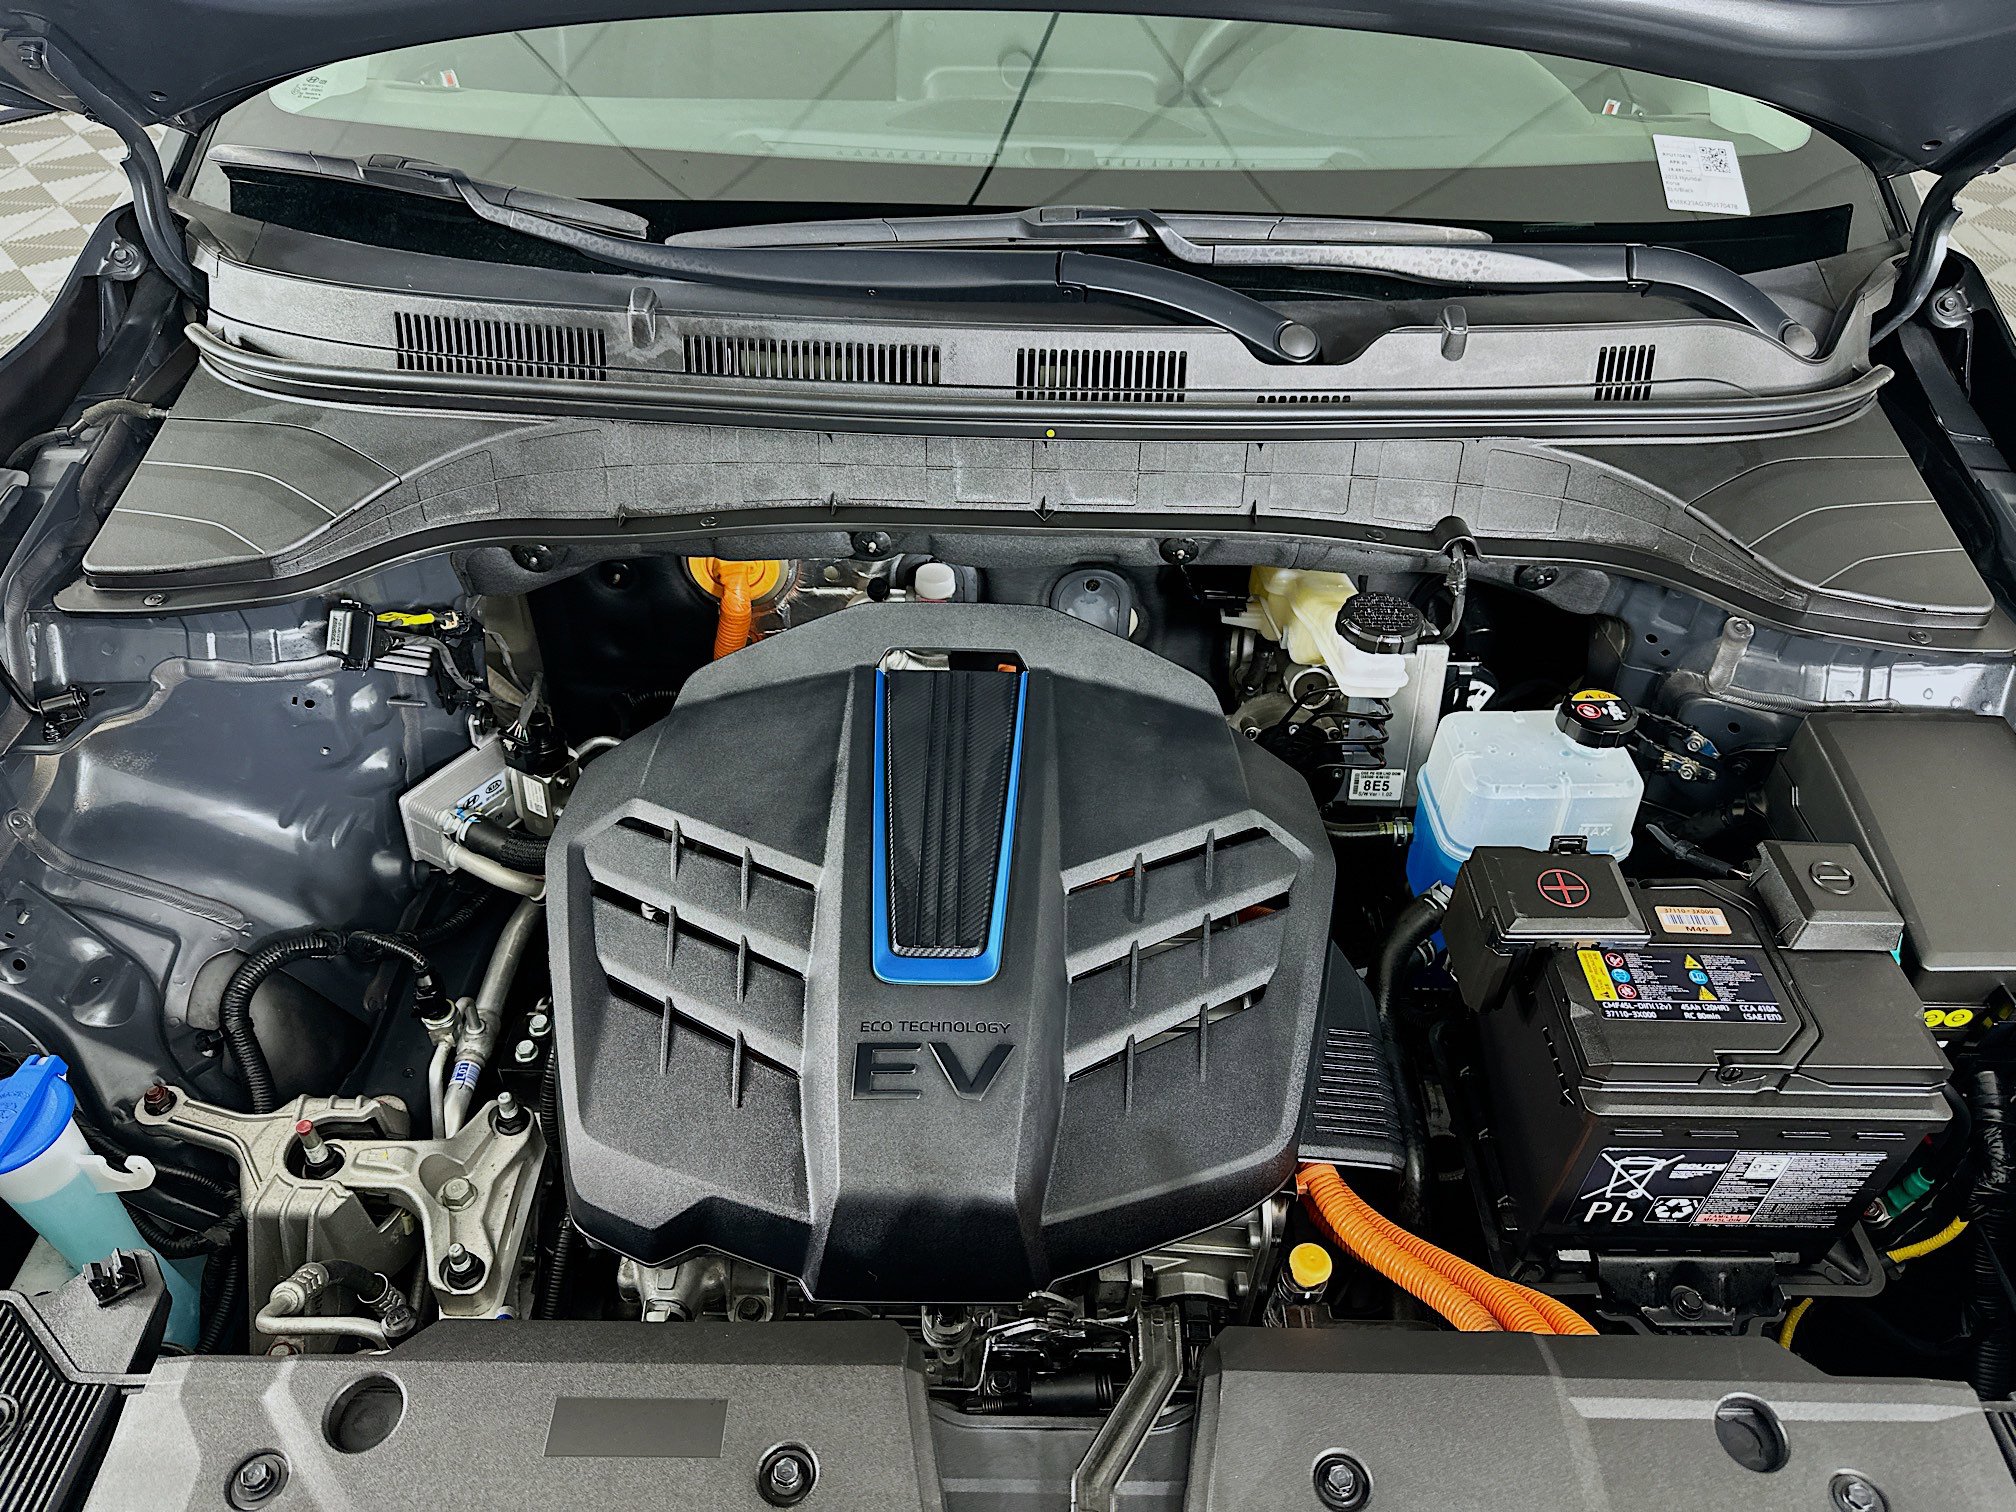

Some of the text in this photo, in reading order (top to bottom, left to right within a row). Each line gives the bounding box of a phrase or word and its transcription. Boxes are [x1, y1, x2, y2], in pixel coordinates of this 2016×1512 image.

[488, 782, 500, 791] KIA
[1363, 780, 1390, 791] 8E5
[1578, 827, 1611, 837] MAX
[1680, 1003, 1702, 1011] 45Ah
[1702, 1003, 1731, 1012] (20HR)
[1757, 1005, 1779, 1013] 410A
[1605, 1010, 1658, 1019] 37110-3X000
[1743, 1013, 1782, 1021] (SAE/EN)
[860, 1021, 1011, 1034] ECO TECHNOLOGY
[851, 1042, 1016, 1101] EV
[1583, 1202, 1634, 1223] Pb
